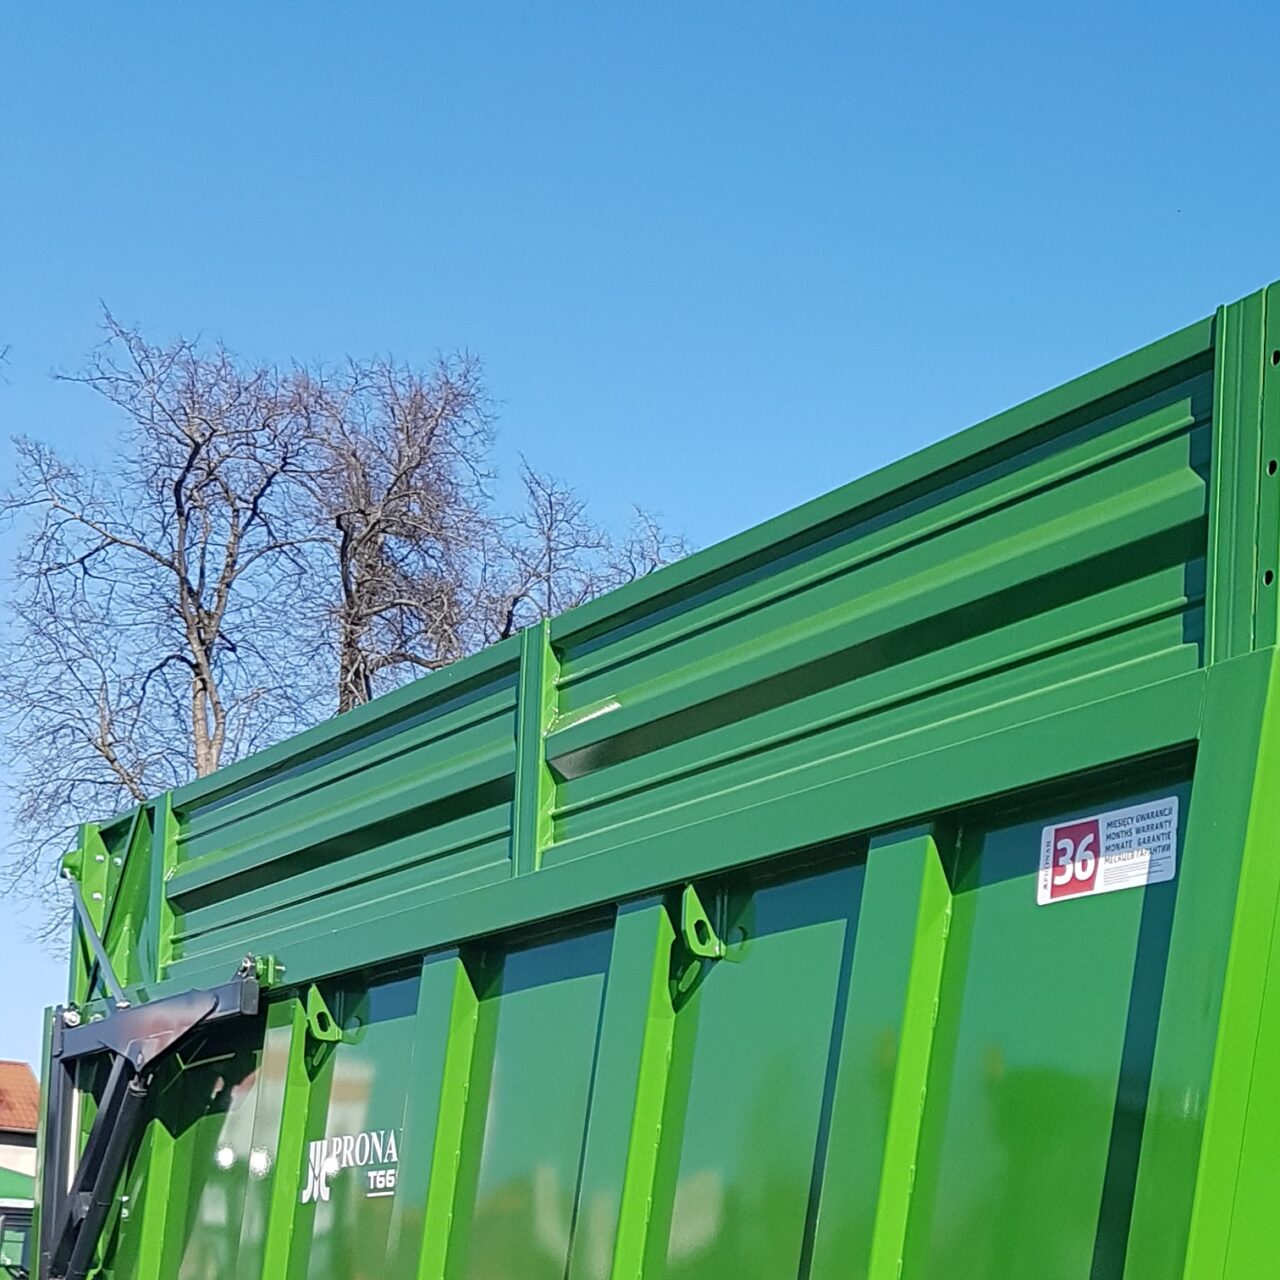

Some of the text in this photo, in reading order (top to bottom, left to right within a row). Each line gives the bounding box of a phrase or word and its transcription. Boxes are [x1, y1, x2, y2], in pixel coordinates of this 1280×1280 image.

[1104, 831, 1171, 853] MONATE GARANTIE
[1105, 820, 1172, 841] MONTHS WARRANTY
[1053, 833, 1096, 886] 36
[331, 1128, 402, 1168] PRONA
